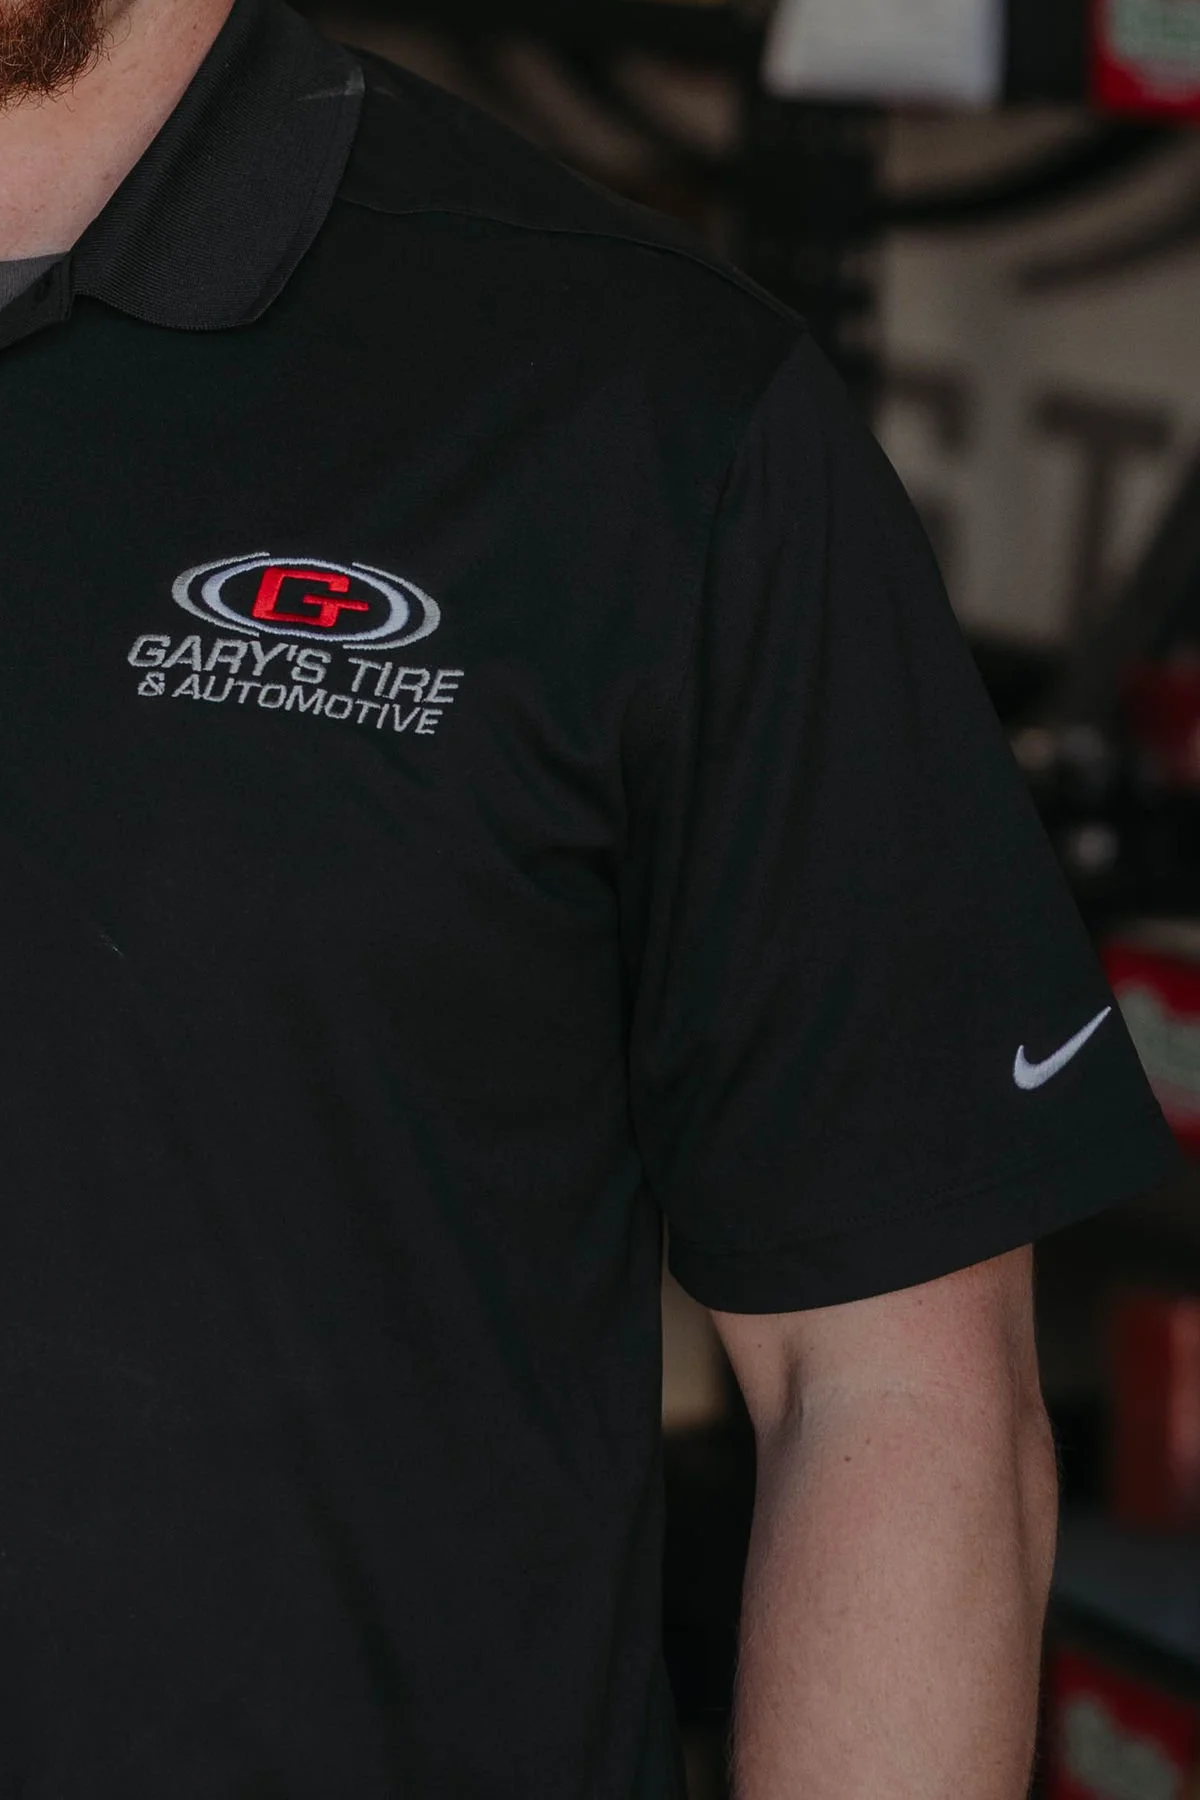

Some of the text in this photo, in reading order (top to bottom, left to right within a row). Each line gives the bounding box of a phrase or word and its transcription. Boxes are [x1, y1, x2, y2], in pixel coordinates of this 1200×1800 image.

[127, 634, 465, 704] GARY'S TIRE
[137, 671, 444, 735] & AUTOMOTIVE
